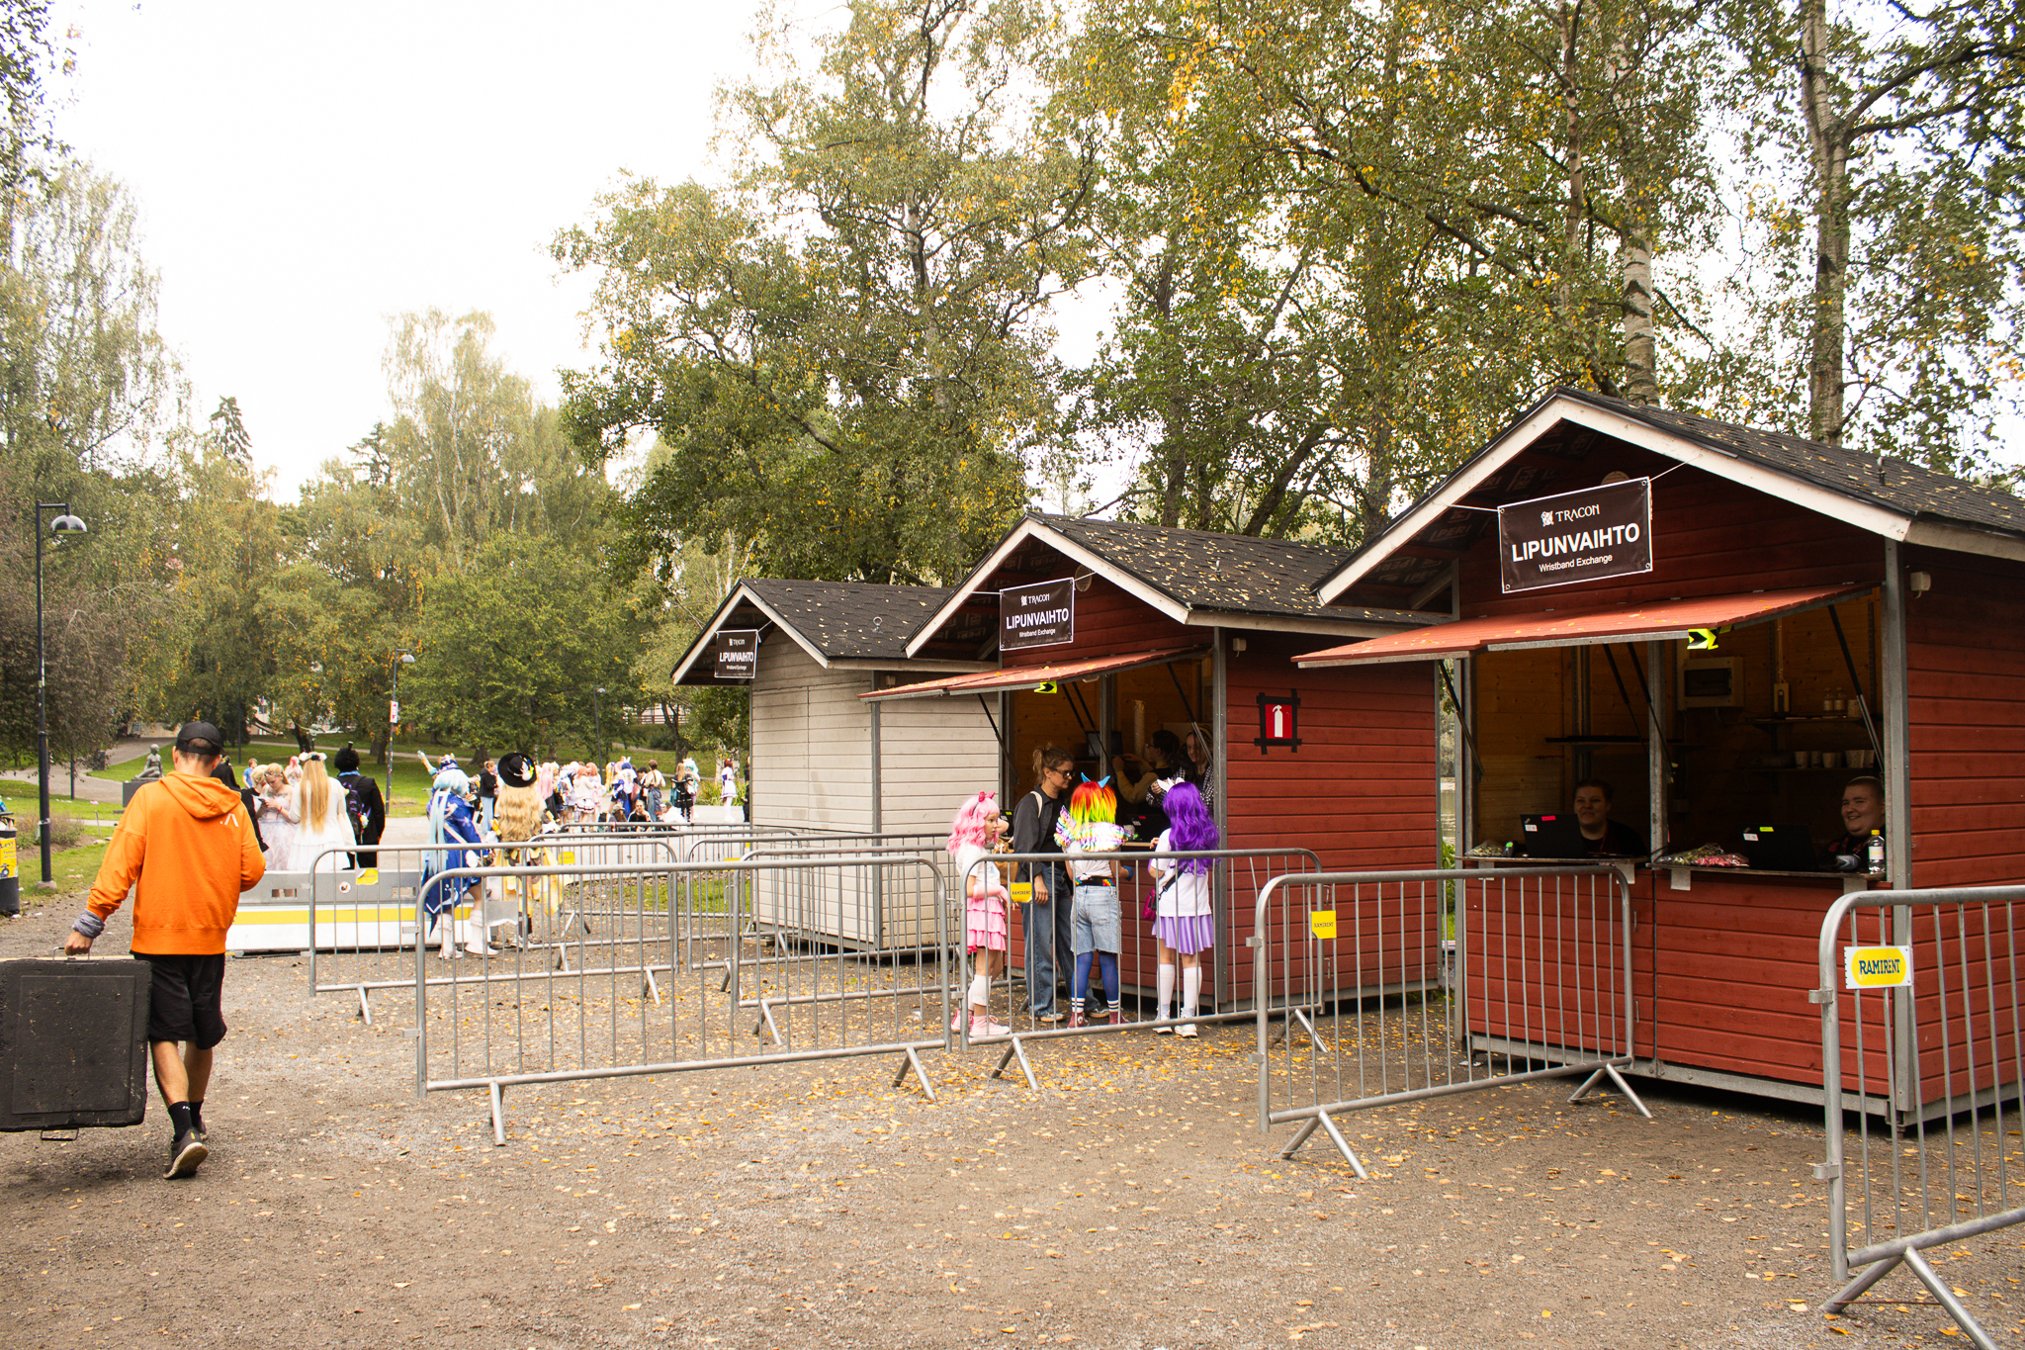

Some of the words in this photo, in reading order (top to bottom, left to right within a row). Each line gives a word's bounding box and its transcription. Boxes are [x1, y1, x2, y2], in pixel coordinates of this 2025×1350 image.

[1555, 504, 1600, 522] TRACON
[1511, 522, 1640, 562] LIPUNVAIHTO
[1538, 558, 1575, 573] Wristband
[1576, 554, 1613, 567] Exchange
[1028, 593, 1050, 605] TRACON
[1006, 608, 1069, 630] LIPUNVAIHTO
[1037, 628, 1056, 636] Exchange
[719, 651, 754, 662] LIPUNVAIHTO
[1858, 959, 1900, 975] RAMIRENT
